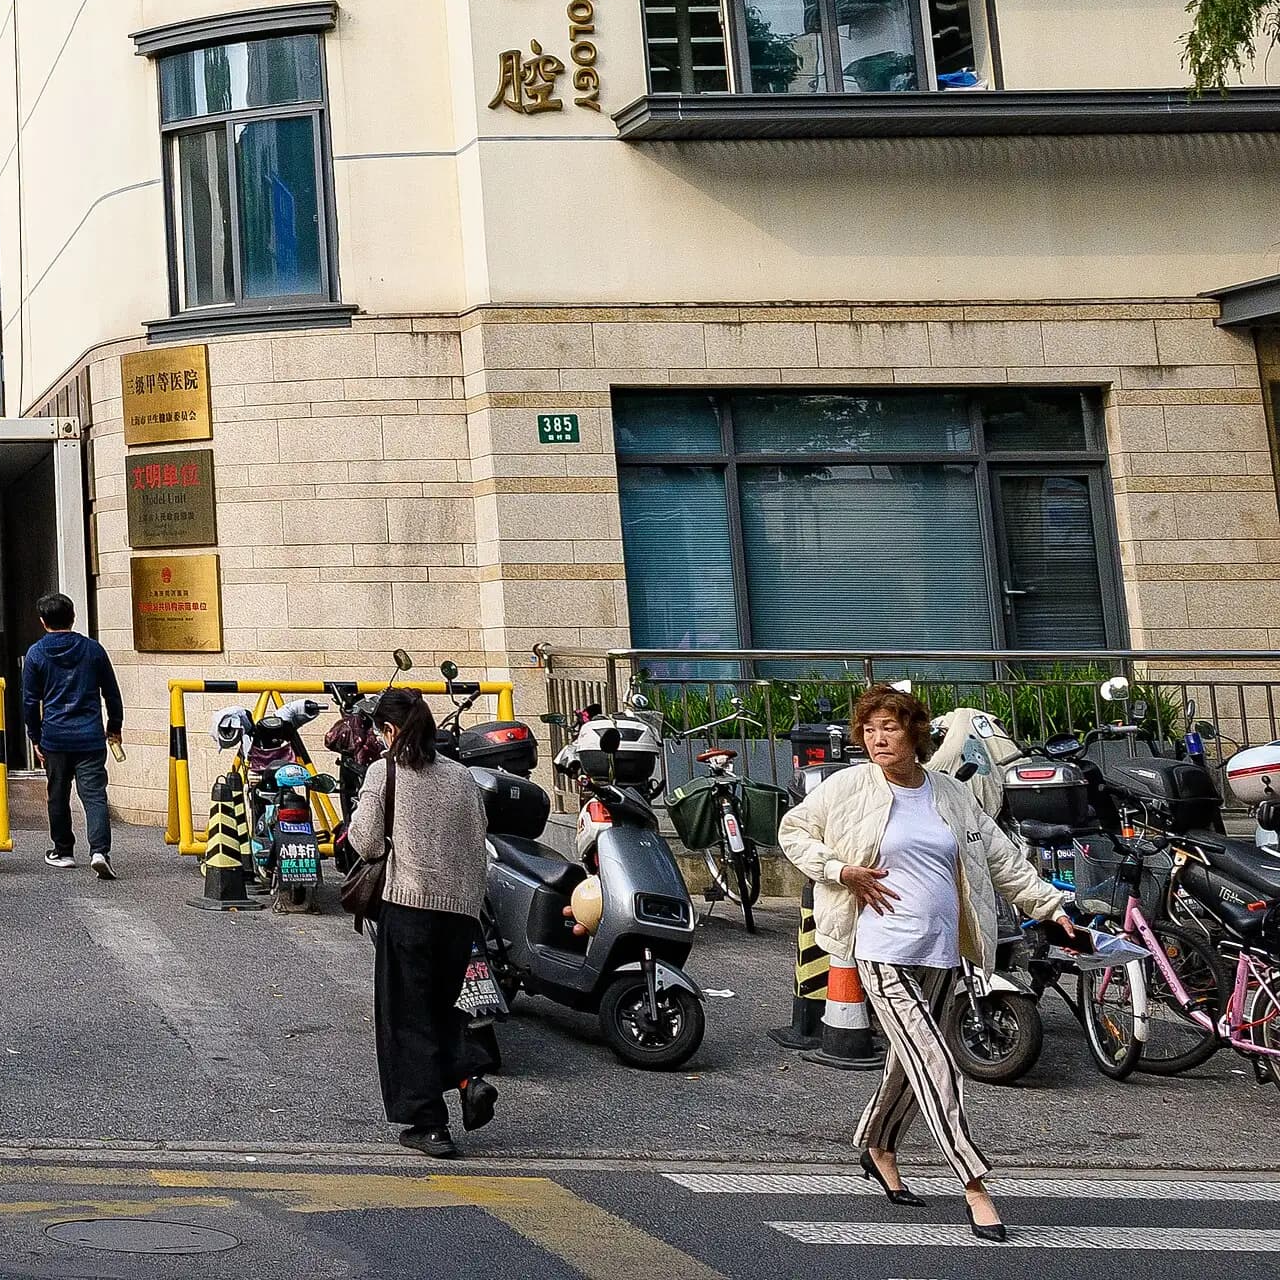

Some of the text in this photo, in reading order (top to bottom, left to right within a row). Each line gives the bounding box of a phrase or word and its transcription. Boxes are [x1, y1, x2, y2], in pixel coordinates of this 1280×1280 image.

[126, 369, 199, 395] 三级甲等医院
[543, 417, 572, 432] 385
[132, 463, 200, 490] 文明单位
